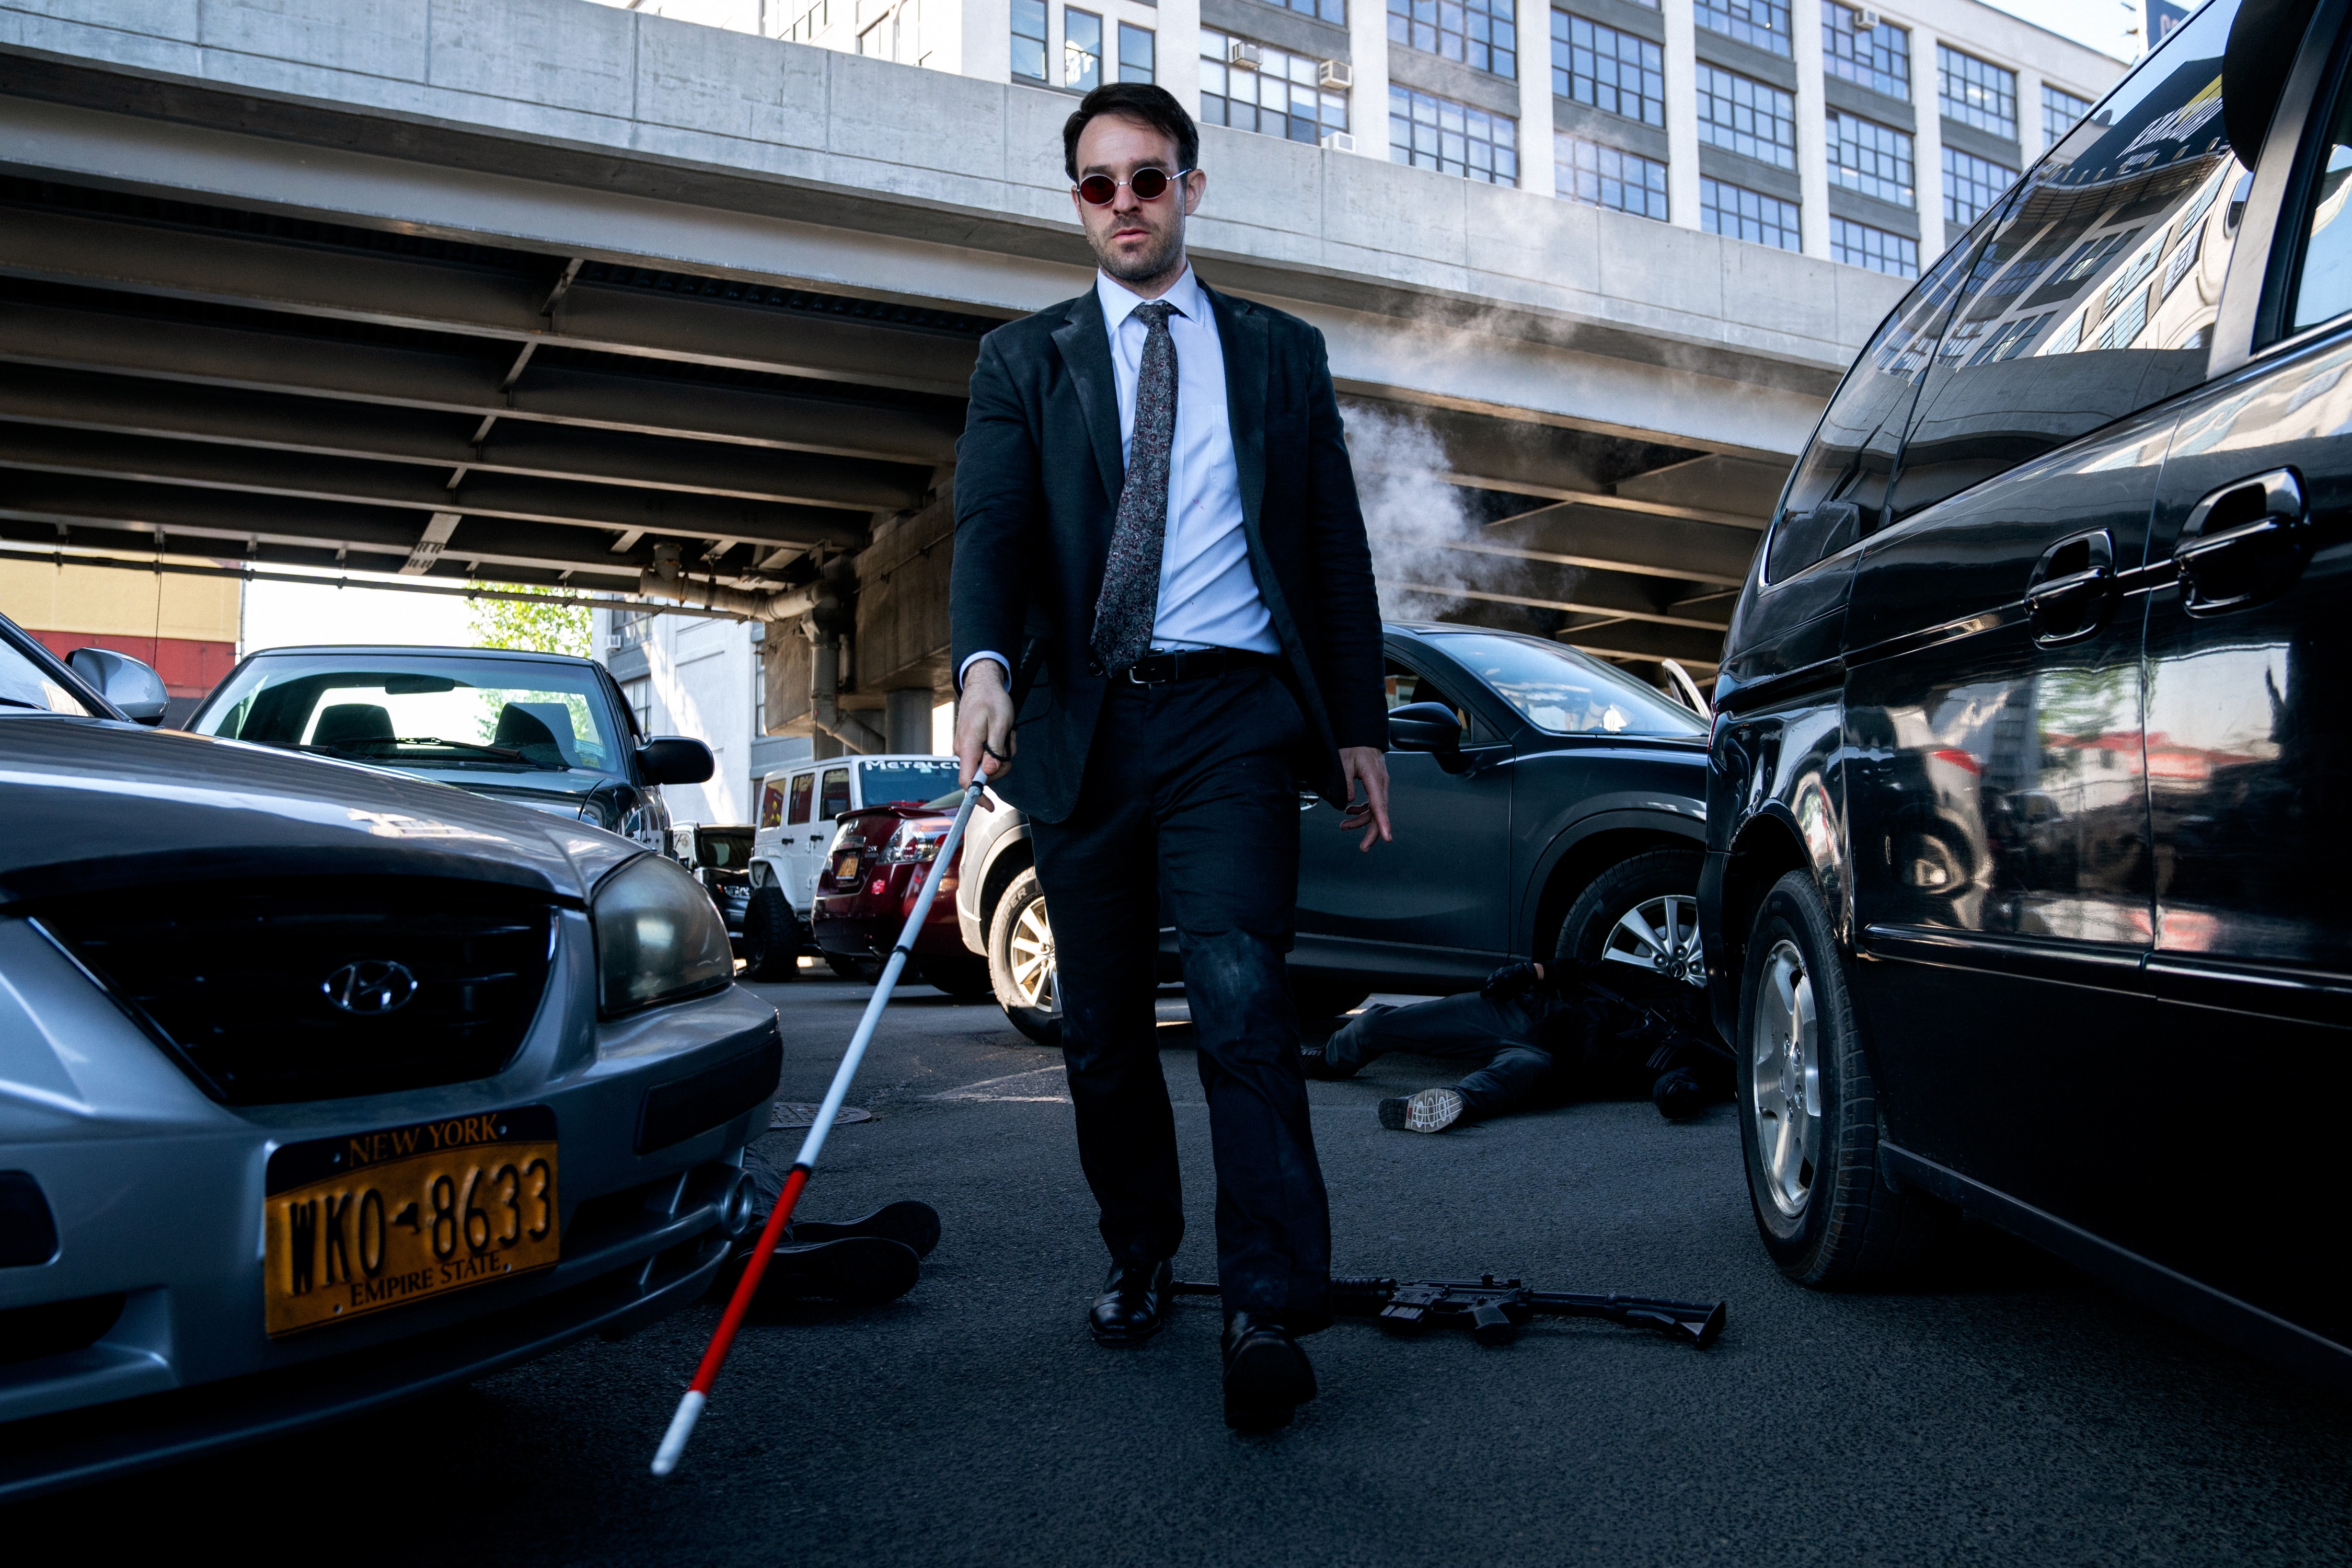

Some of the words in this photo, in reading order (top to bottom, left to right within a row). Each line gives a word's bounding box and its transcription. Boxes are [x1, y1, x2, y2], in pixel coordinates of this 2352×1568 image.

[350, 1128, 420, 1168] NEW
[429, 1114, 499, 1149] YORK
[289, 1187, 385, 1296] WKO
[432, 1158, 551, 1260] 8633
[350, 1271, 433, 1307] EMPIRE
[440, 1250, 500, 1284] STATE
